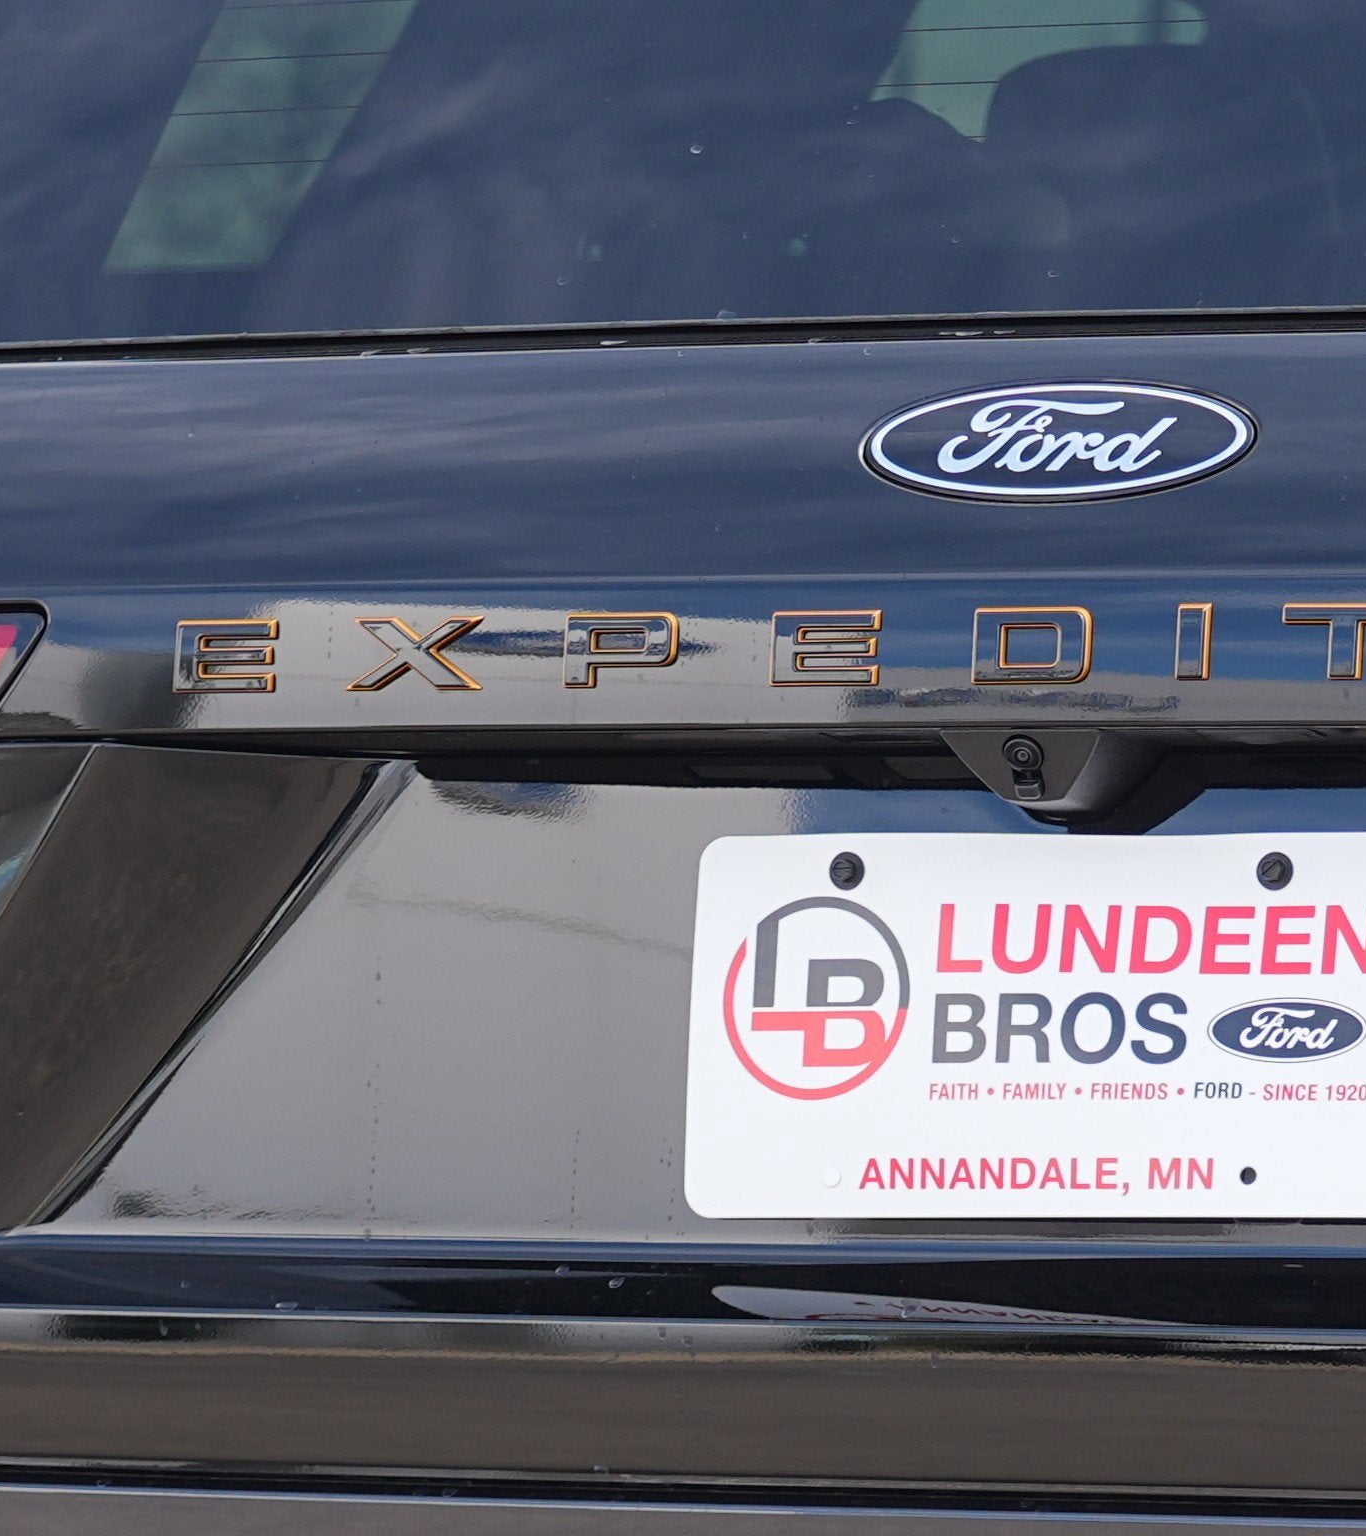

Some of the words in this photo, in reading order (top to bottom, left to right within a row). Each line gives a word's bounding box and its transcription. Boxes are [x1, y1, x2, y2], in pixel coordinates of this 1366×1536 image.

[937, 399, 1178, 474] Ford
[930, 991, 1189, 1065] BROS
[1240, 1007, 1338, 1052] Ford
[928, 1082, 979, 1101] FAITH
[1002, 1083, 1067, 1101] FAMILY
[1090, 1083, 1169, 1101] FRIENDS
[1193, 1082, 1243, 1100] FORD
[1262, 1083, 1319, 1101] SINCE
[858, 1157, 1131, 1196] ANNANDALE,
[1148, 1158, 1215, 1190] MN
